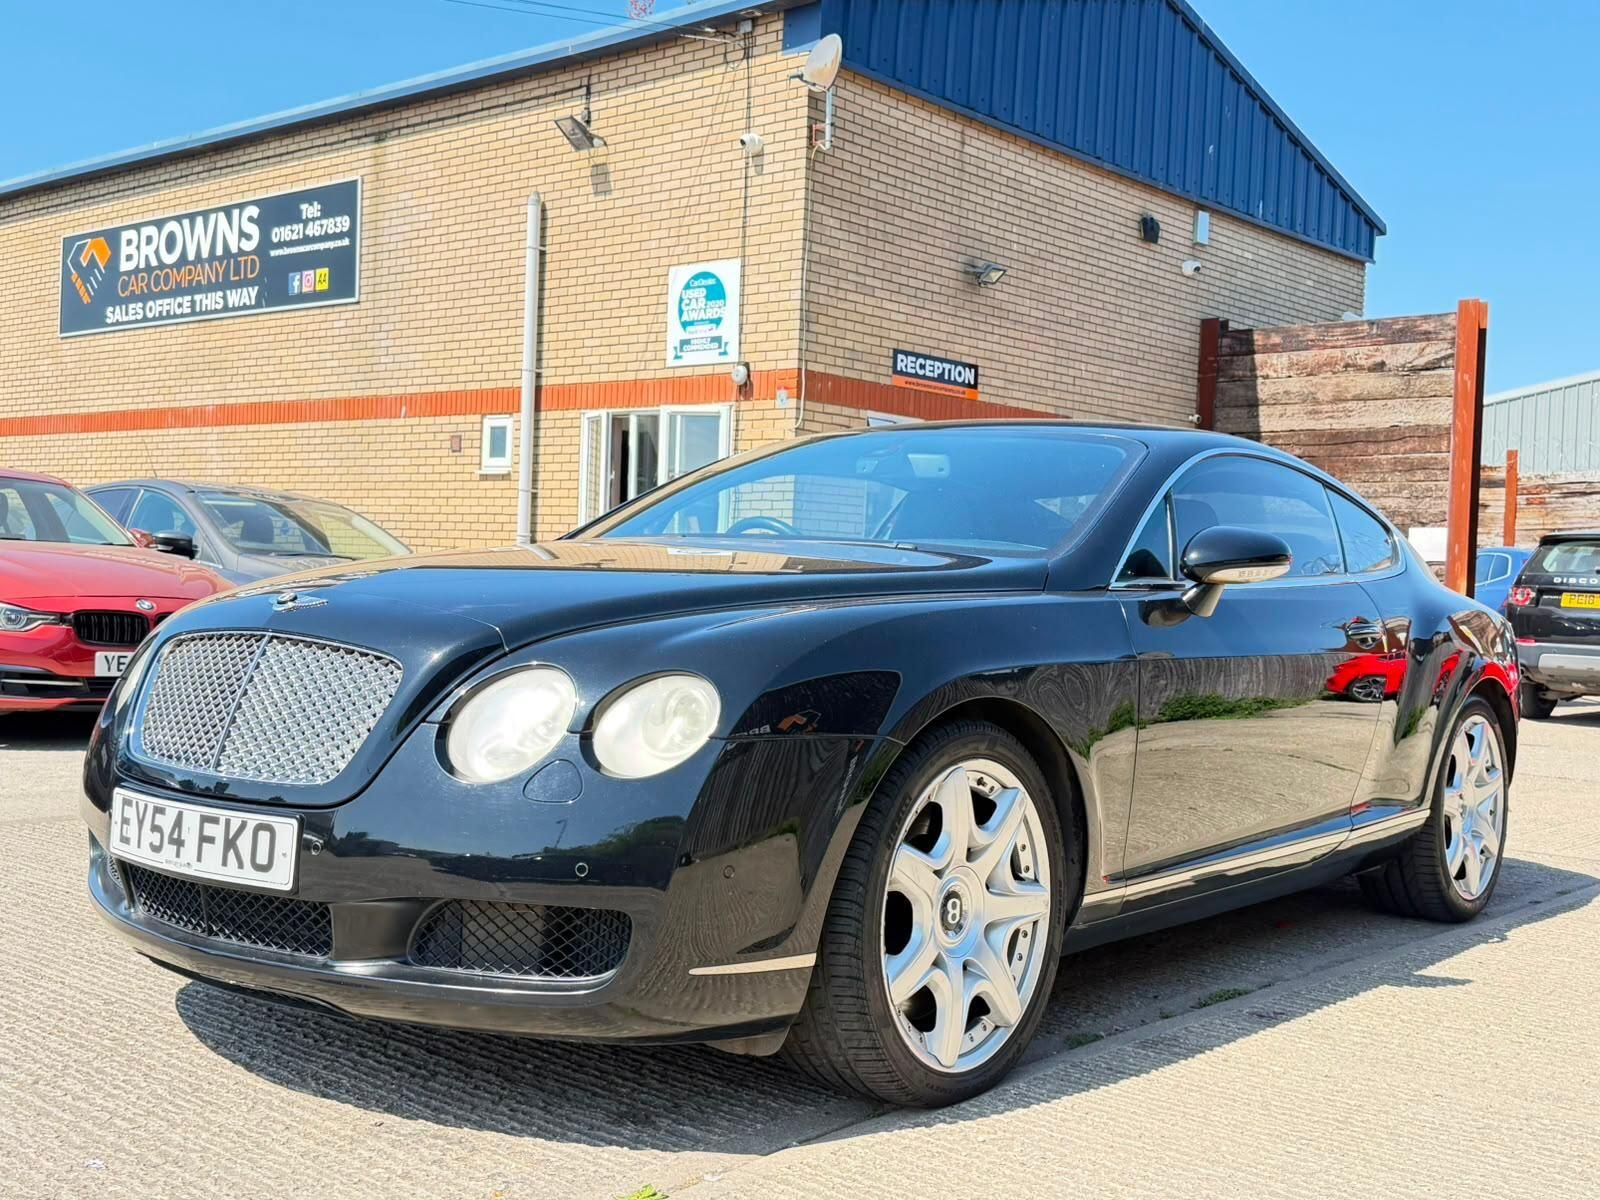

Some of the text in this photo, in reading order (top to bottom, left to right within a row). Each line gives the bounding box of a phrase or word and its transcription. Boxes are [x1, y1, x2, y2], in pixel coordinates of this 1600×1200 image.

[299, 201, 321, 219] Tel:
[119, 205, 260, 272] BROWNS
[271, 215, 351, 243] 01621 467839
[118, 255, 260, 298] CAR COMPANY LTD
[106, 286, 259, 324] SALES OFFICE THIS WAY
[681, 297, 706, 311] CAR
[682, 287, 707, 299] USED
[681, 307, 728, 322] AWARDS
[896, 353, 975, 385] RECEPTION
[104, 655, 128, 673] YE
[119, 797, 277, 873] EY54 FKO
